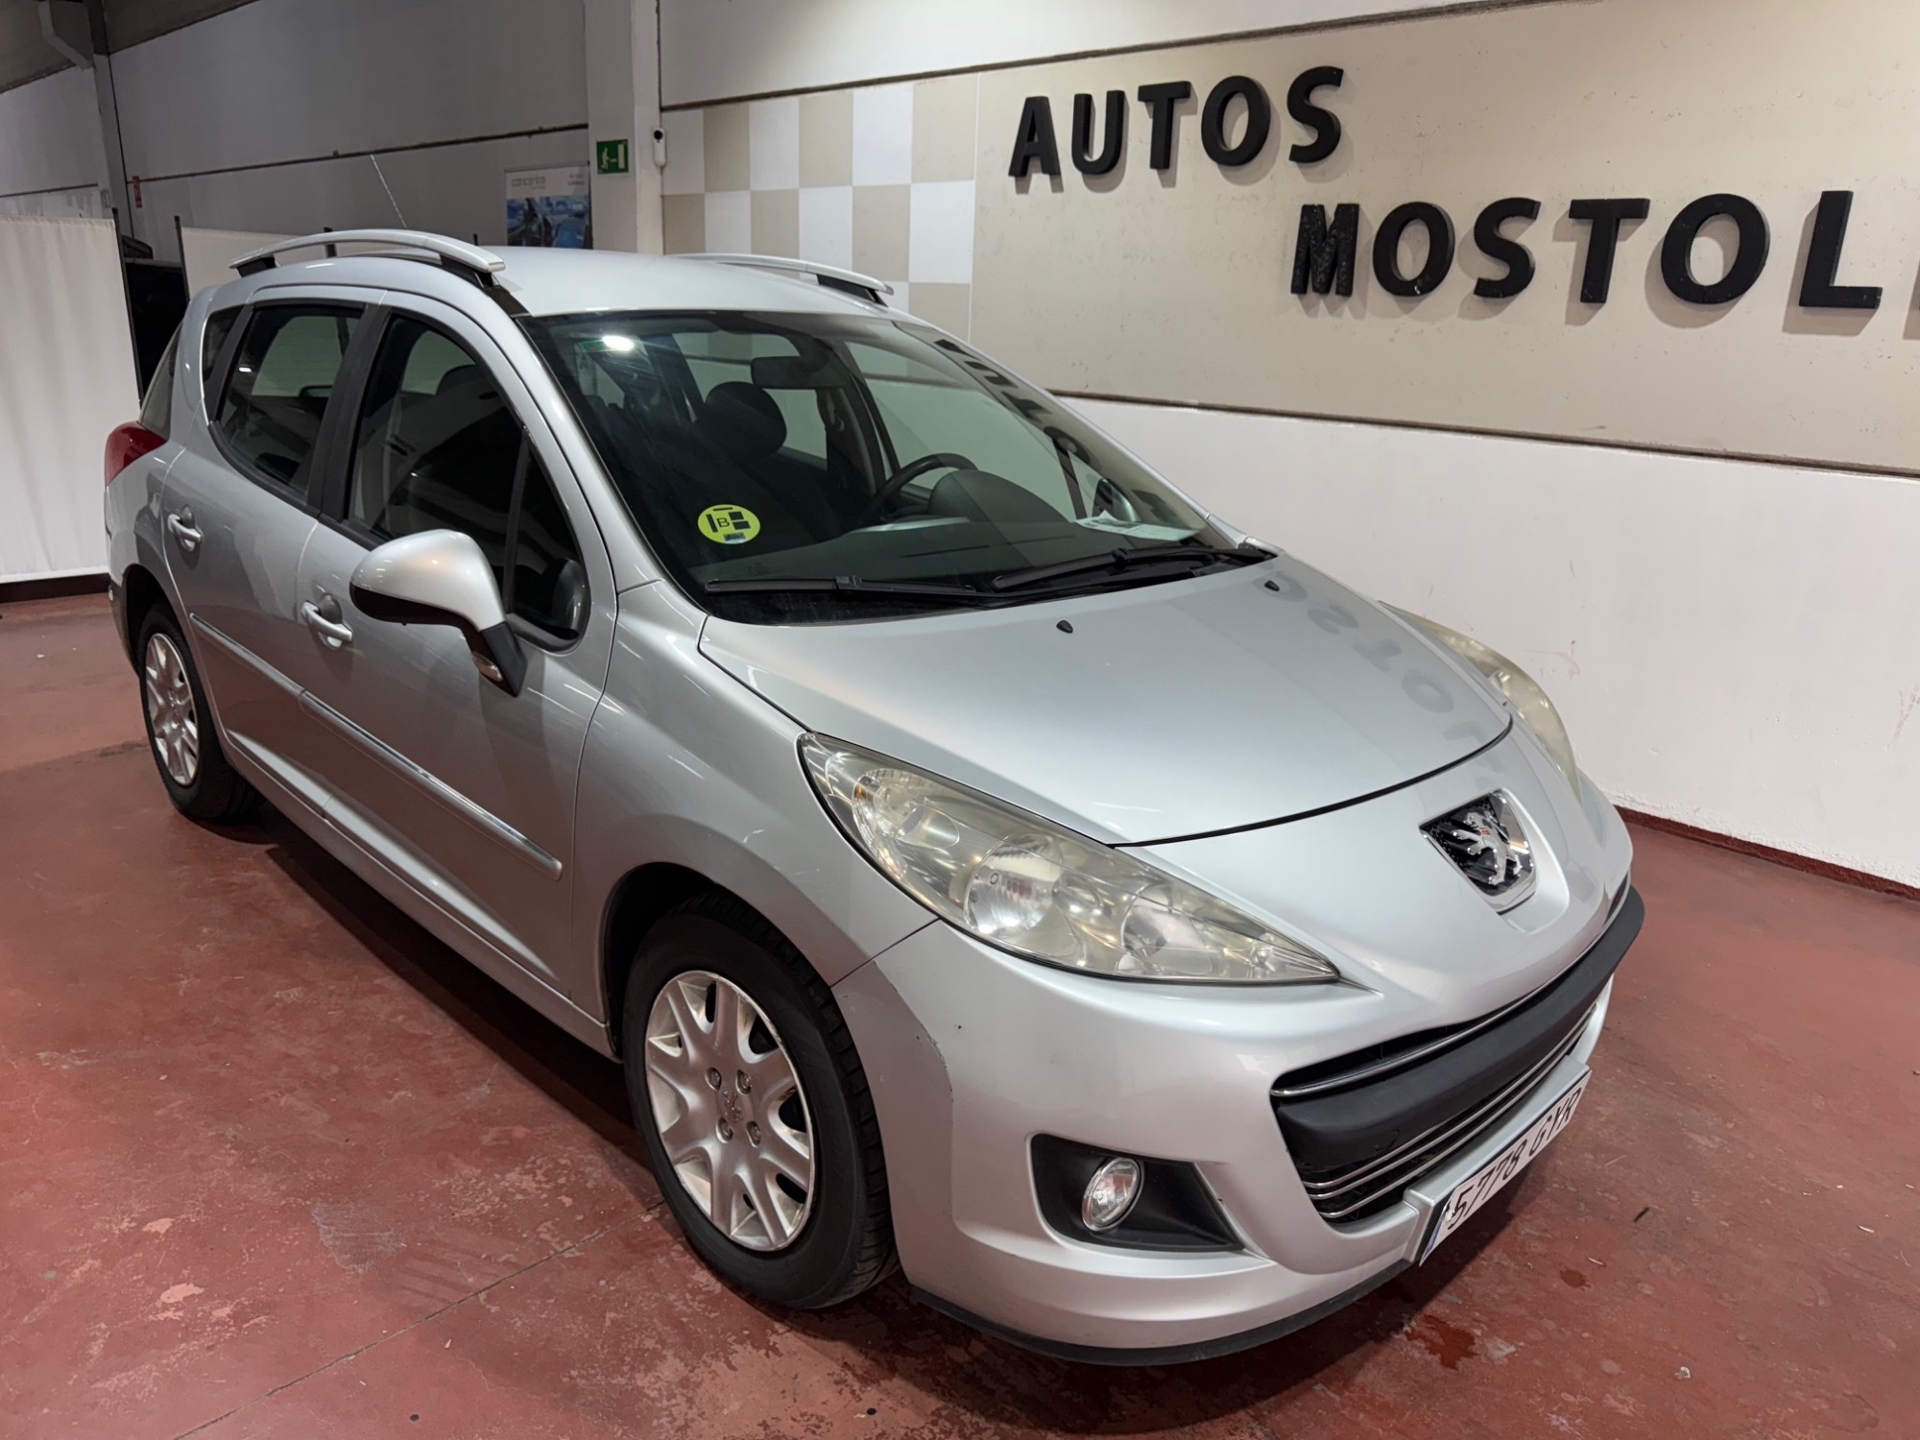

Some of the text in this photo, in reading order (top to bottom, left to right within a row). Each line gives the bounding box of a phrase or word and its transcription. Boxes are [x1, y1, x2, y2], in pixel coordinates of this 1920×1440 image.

[1008, 66, 1344, 181] AUTOS
[1290, 190, 1920, 311] MOSTOL
[716, 517, 730, 528] B
[1447, 1087, 1582, 1230] 5778 GYR
